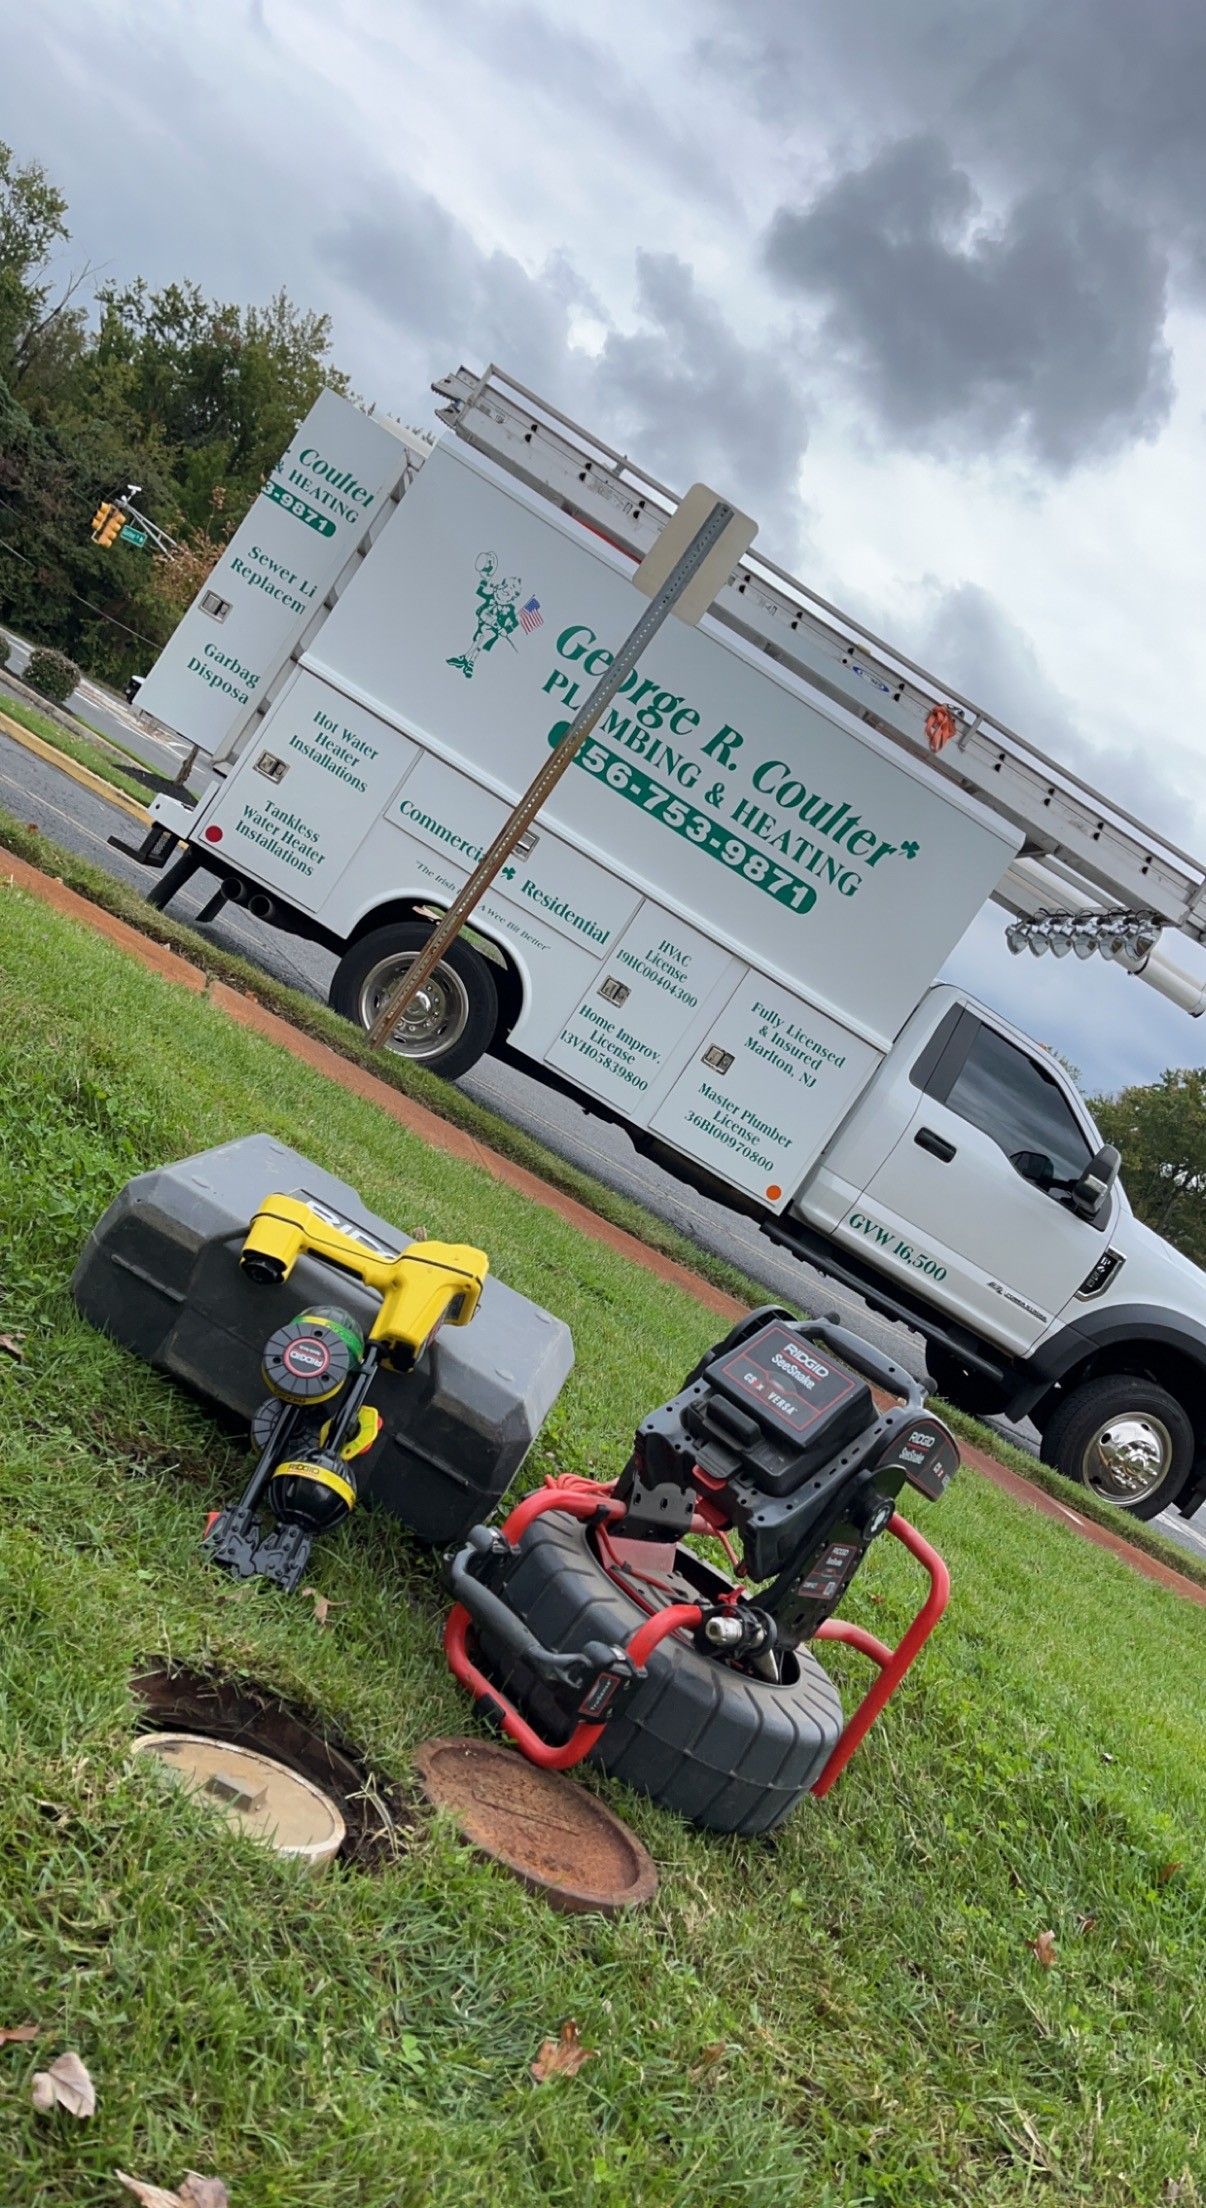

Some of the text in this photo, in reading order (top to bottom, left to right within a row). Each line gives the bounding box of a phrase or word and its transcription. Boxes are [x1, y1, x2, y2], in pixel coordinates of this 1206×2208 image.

[288, 469, 359, 523] HEATING
[248, 546, 318, 598] Sewer Li
[187, 657, 249, 704] Disposa
[204, 643, 261, 689] Garbag
[313, 711, 379, 760] Hot Water
[314, 732, 360, 768] Heater
[289, 735, 368, 793] Installations
[542, 669, 862, 897] PLMBING & HEATING
[264, 800, 320, 843] Tankless
[700, 724, 744, 771] R.
[752, 760, 898, 867] Coulter
[235, 820, 314, 877] Installations
[243, 805, 325, 865] Water Heater
[575, 741, 809, 909] 56-753-9871
[400, 800, 610, 945] Commerci Residential
[616, 949, 698, 1008] 19HC00404300
[645, 950, 688, 983] License
[658, 940, 692, 967] HVAC
[579, 1005, 661, 1064] Home Improv.
[590, 1029, 636, 1065] License
[750, 1002, 846, 1069] Fully Licensed
[758, 1025, 822, 1071] & Insured
[560, 1030, 649, 1092] 13VH05839800
[744, 1036, 817, 1088] Marlton, NJ
[699, 1083, 793, 1149] Master Plumber
[712, 1110, 761, 1146] License
[849, 1213, 948, 1282] GVW 16,500
[771, 1353, 815, 1390] SeeSnake
[783, 1343, 829, 1378] RIDGID
[767, 1392, 796, 1415] VERSA
